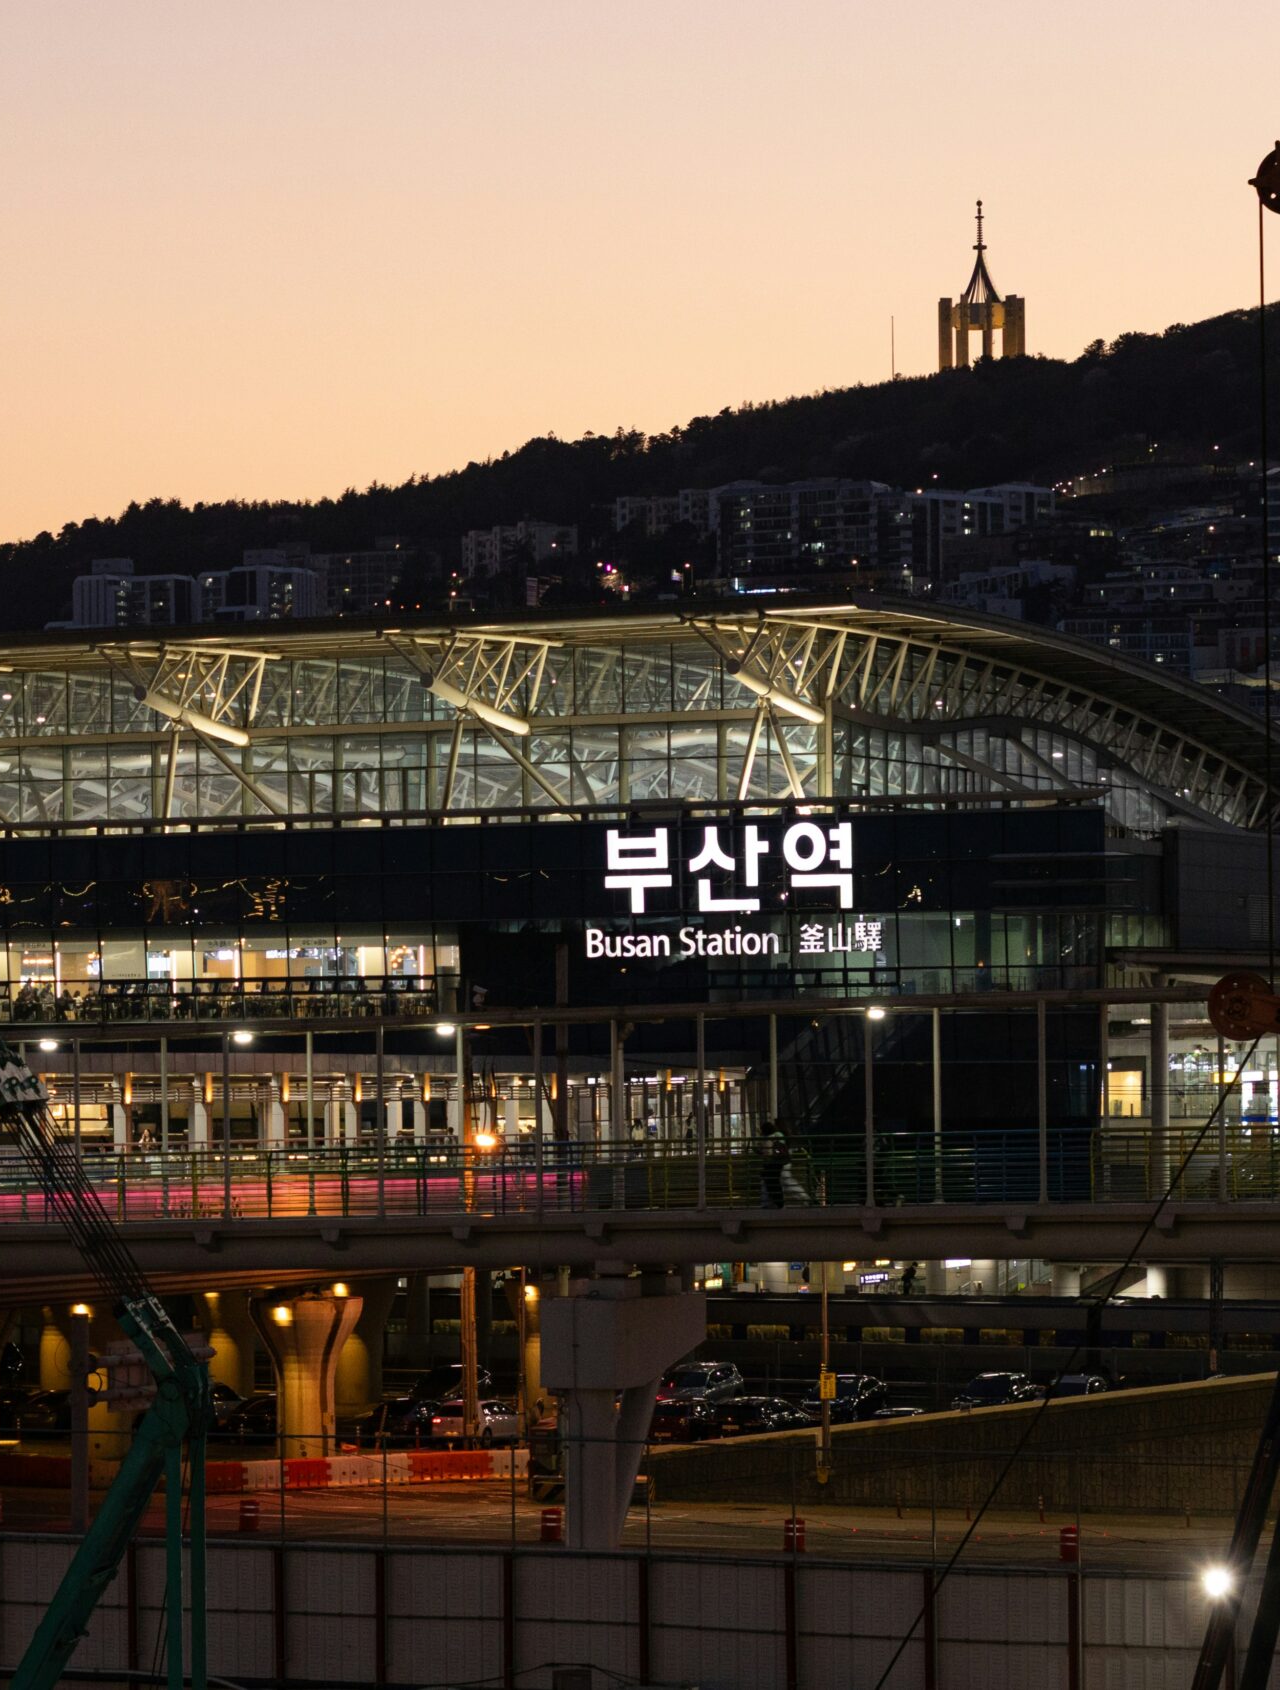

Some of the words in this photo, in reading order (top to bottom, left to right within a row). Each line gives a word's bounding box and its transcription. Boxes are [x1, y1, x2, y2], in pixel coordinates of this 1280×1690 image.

[604, 822, 853, 914] 부산역
[586, 929, 670, 958] Busan
[679, 925, 780, 956] Station
[799, 922, 883, 953] 釜山驛
